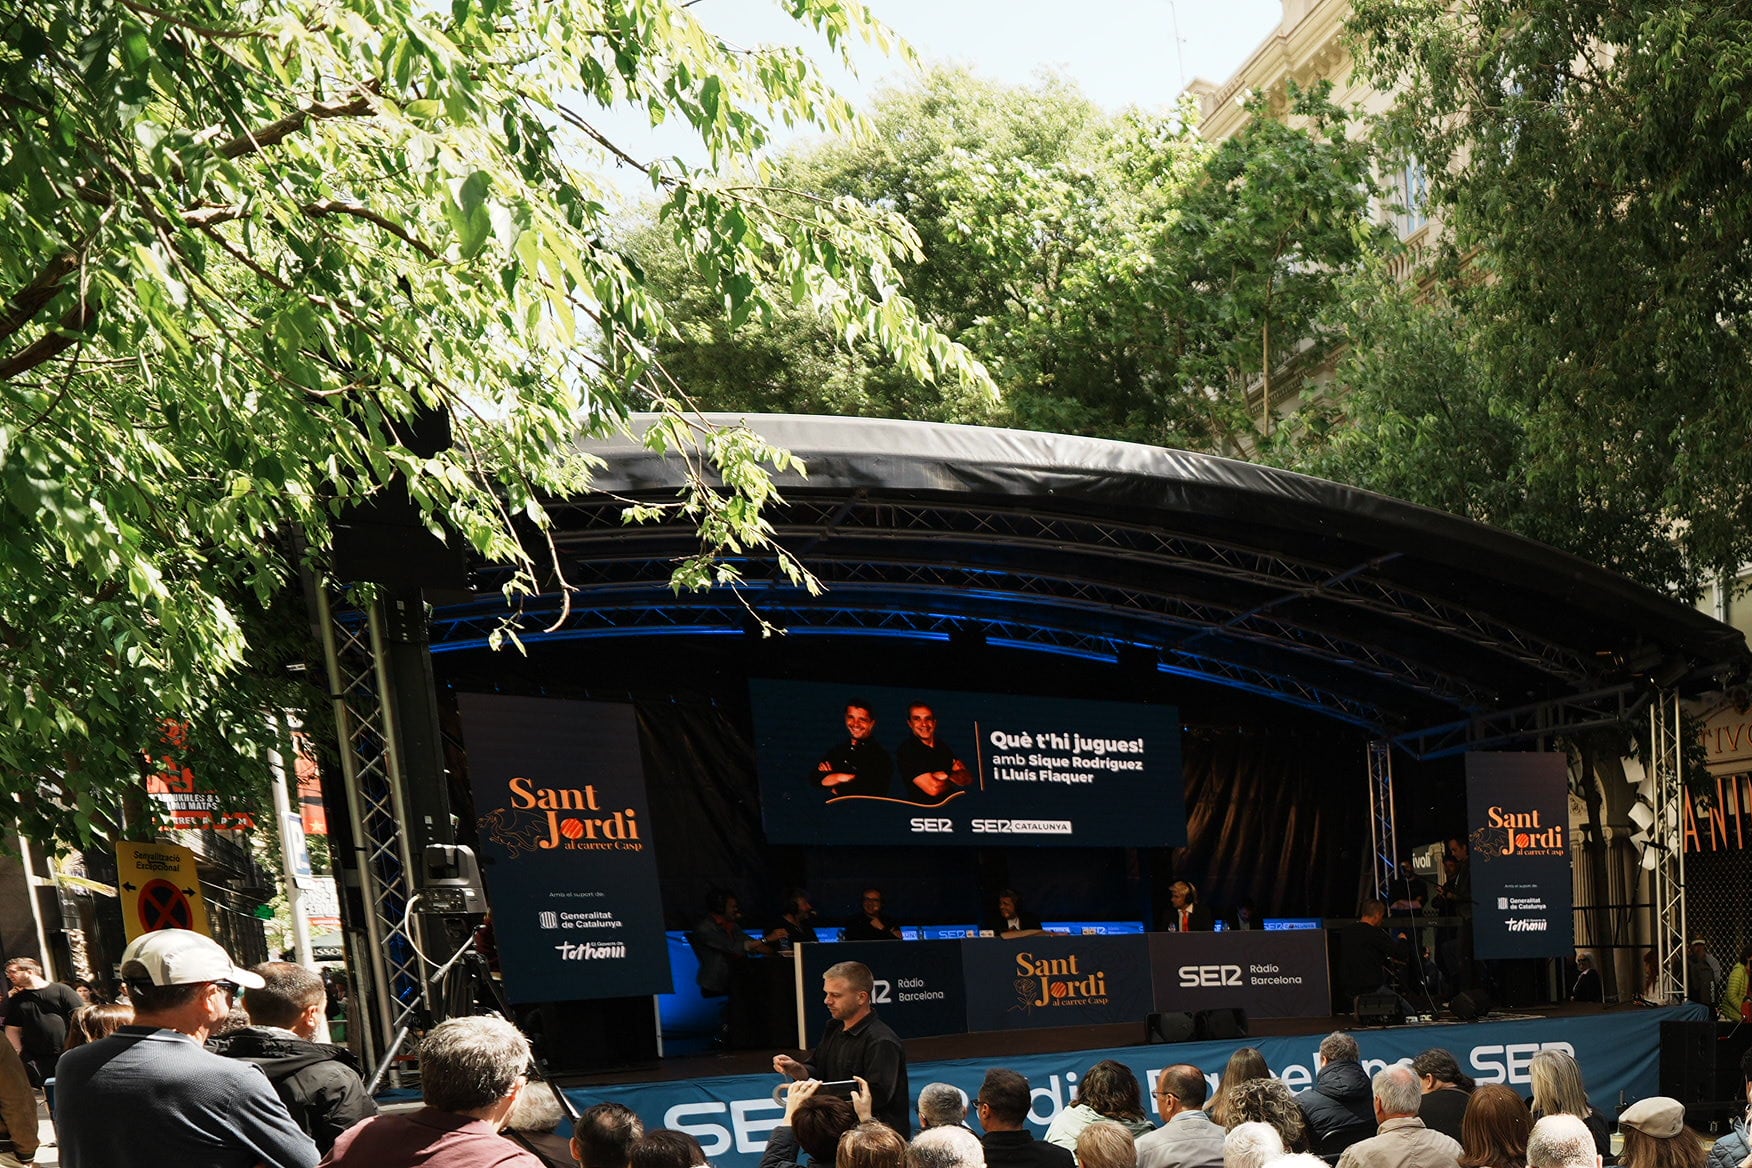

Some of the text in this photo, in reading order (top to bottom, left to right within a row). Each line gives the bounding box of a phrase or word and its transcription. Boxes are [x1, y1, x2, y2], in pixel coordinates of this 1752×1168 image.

[990, 730, 1144, 755] Què t'hi jugues!
[992, 753, 1143, 772] amb Sique Rodríguez
[994, 767, 1095, 785] i Lluís Flaquer
[508, 777, 600, 810] Sant
[1487, 805, 1542, 829] Sant
[539, 808, 641, 849] Jordi
[910, 818, 953, 833] SER
[971, 819, 1068, 833] SER CATALUNYA
[564, 841, 643, 852] al carrer Casp
[1501, 825, 1564, 856] Jordi
[133, 851, 181, 864] Senyalització
[1412, 853, 1431, 869] ivoli
[135, 860, 180, 873] Excepcional
[560, 911, 614, 920] Generalitat
[561, 920, 624, 930] de Catalunya
[1015, 951, 1080, 978] Sant
[1249, 963, 1279, 974] Ràdio
[897, 978, 924, 989] Ràdio
[1178, 964, 1243, 988] SER
[1250, 974, 1302, 985] Barcelona
[898, 990, 944, 1002] Barcelona
[1034, 970, 1108, 1008] Jordi
[1052, 998, 1060, 1006] al
[1088, 996, 1109, 1007] Casp
[664, 1098, 790, 1157] SE
